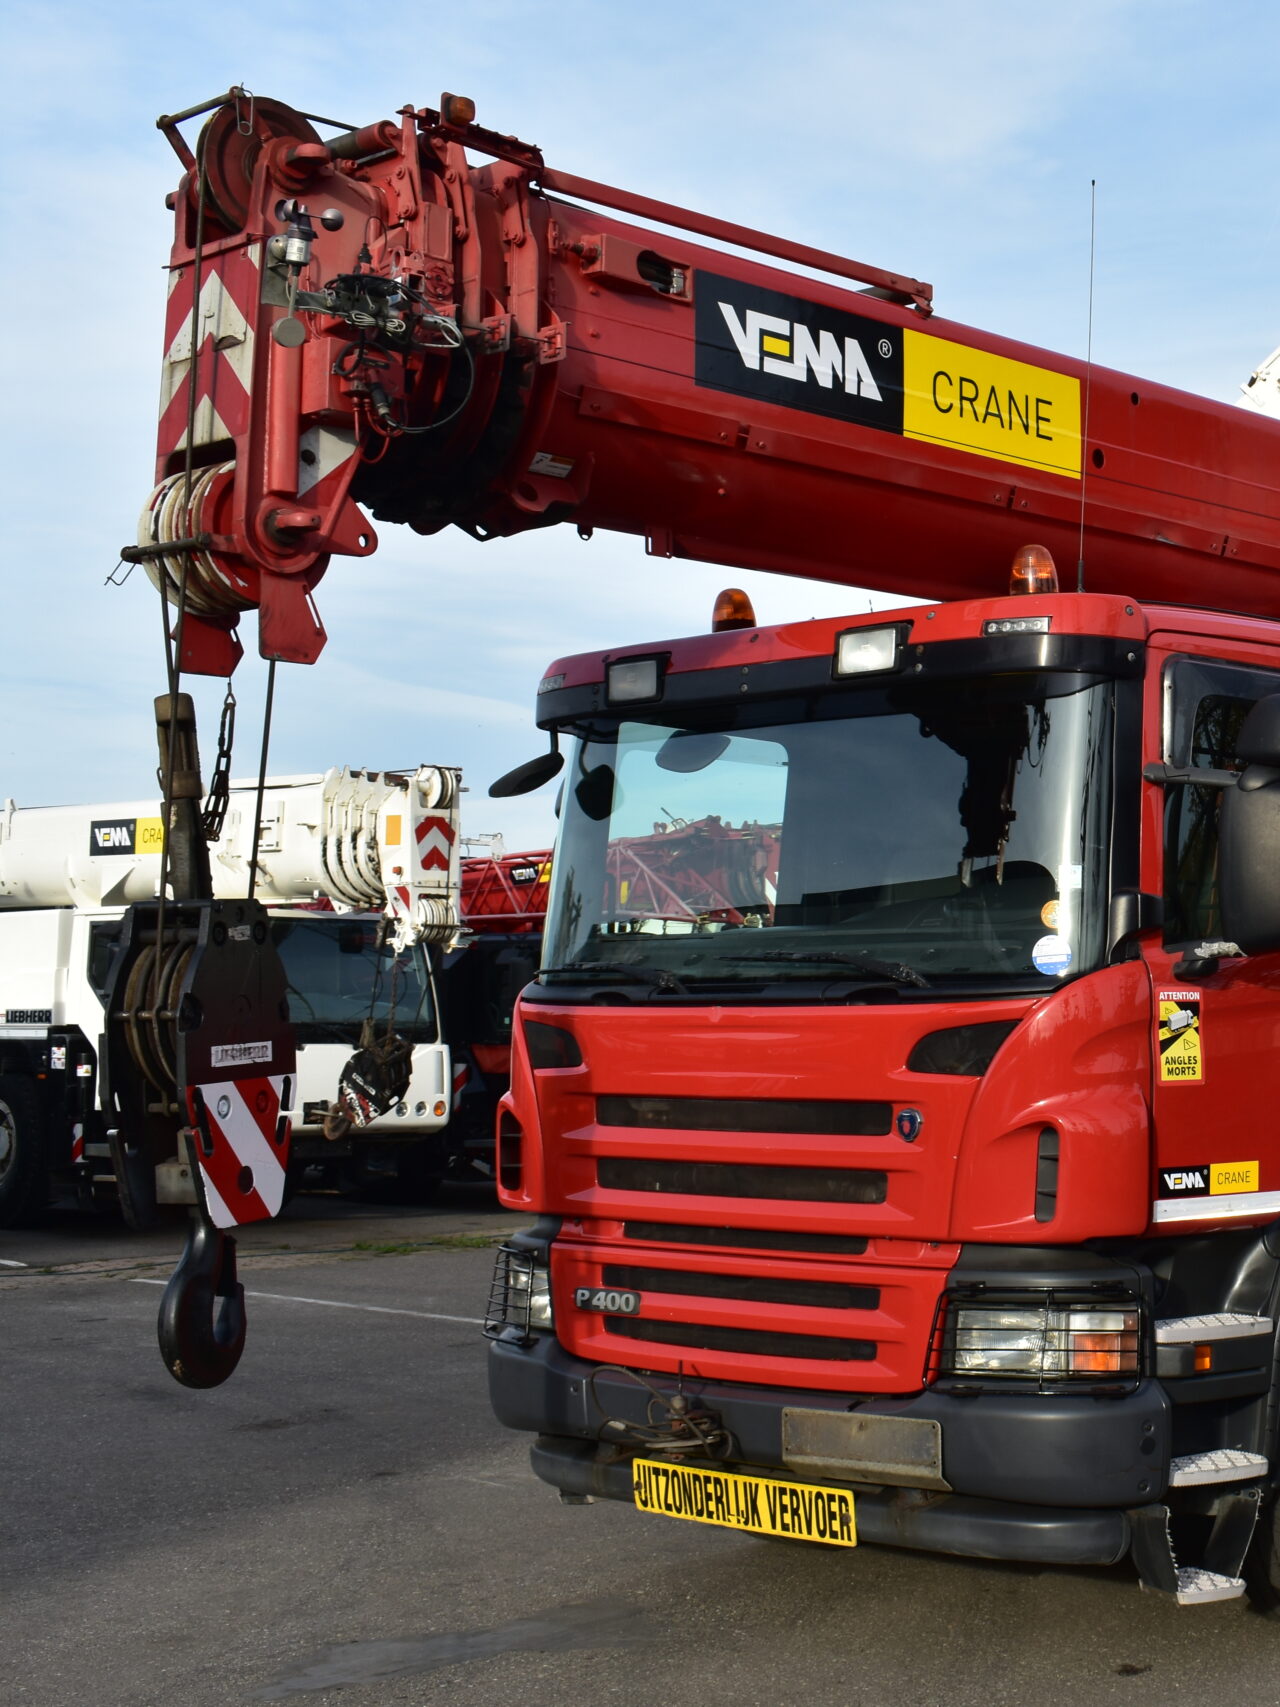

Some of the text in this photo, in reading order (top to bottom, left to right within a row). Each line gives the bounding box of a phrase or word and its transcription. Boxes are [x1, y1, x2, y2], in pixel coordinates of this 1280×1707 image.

[932, 370, 1053, 441] CRANE
[94, 826, 163, 847] VEMA CRA
[1159, 991, 1200, 1000] ATTENTION
[6, 1009, 52, 1024] LIEBHERR
[1164, 1055, 1198, 1066] ANGLES
[1166, 1066, 1197, 1077] MORTS
[1163, 1170, 1251, 1190] VEMA CRANE
[576, 1289, 635, 1312] P 400
[635, 1463, 852, 1542] UITZONDERLIJK VERVOER
